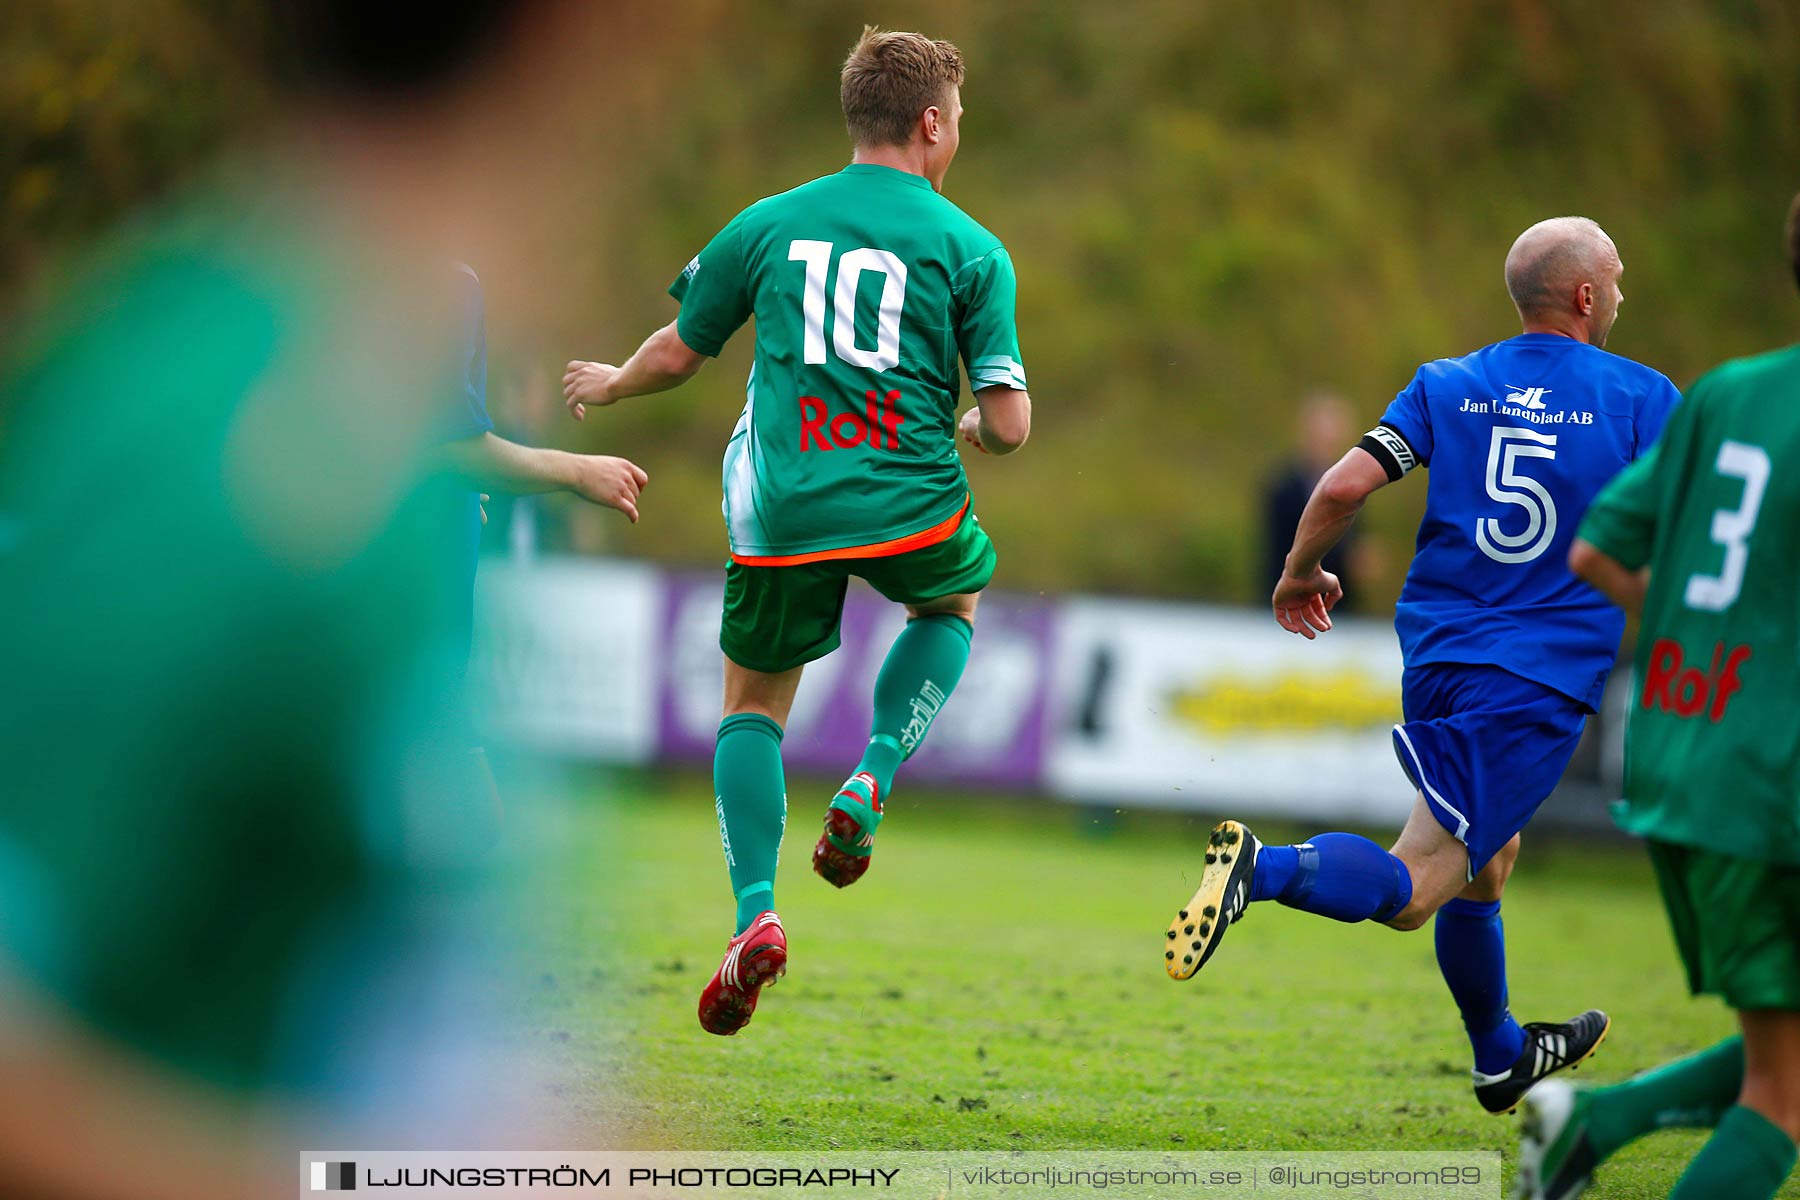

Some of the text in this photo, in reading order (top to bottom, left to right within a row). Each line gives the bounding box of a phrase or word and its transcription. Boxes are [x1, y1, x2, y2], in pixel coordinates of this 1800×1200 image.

[788, 239, 908, 373] 10
[799, 389, 905, 452] Rolf
[1459, 398, 1594, 425] Jan Lundblad AB
[1475, 425, 1557, 564] 5
[1684, 440, 1771, 612] 3
[900, 679, 945, 754] stadium
[1641, 638, 1752, 724] Rolf
